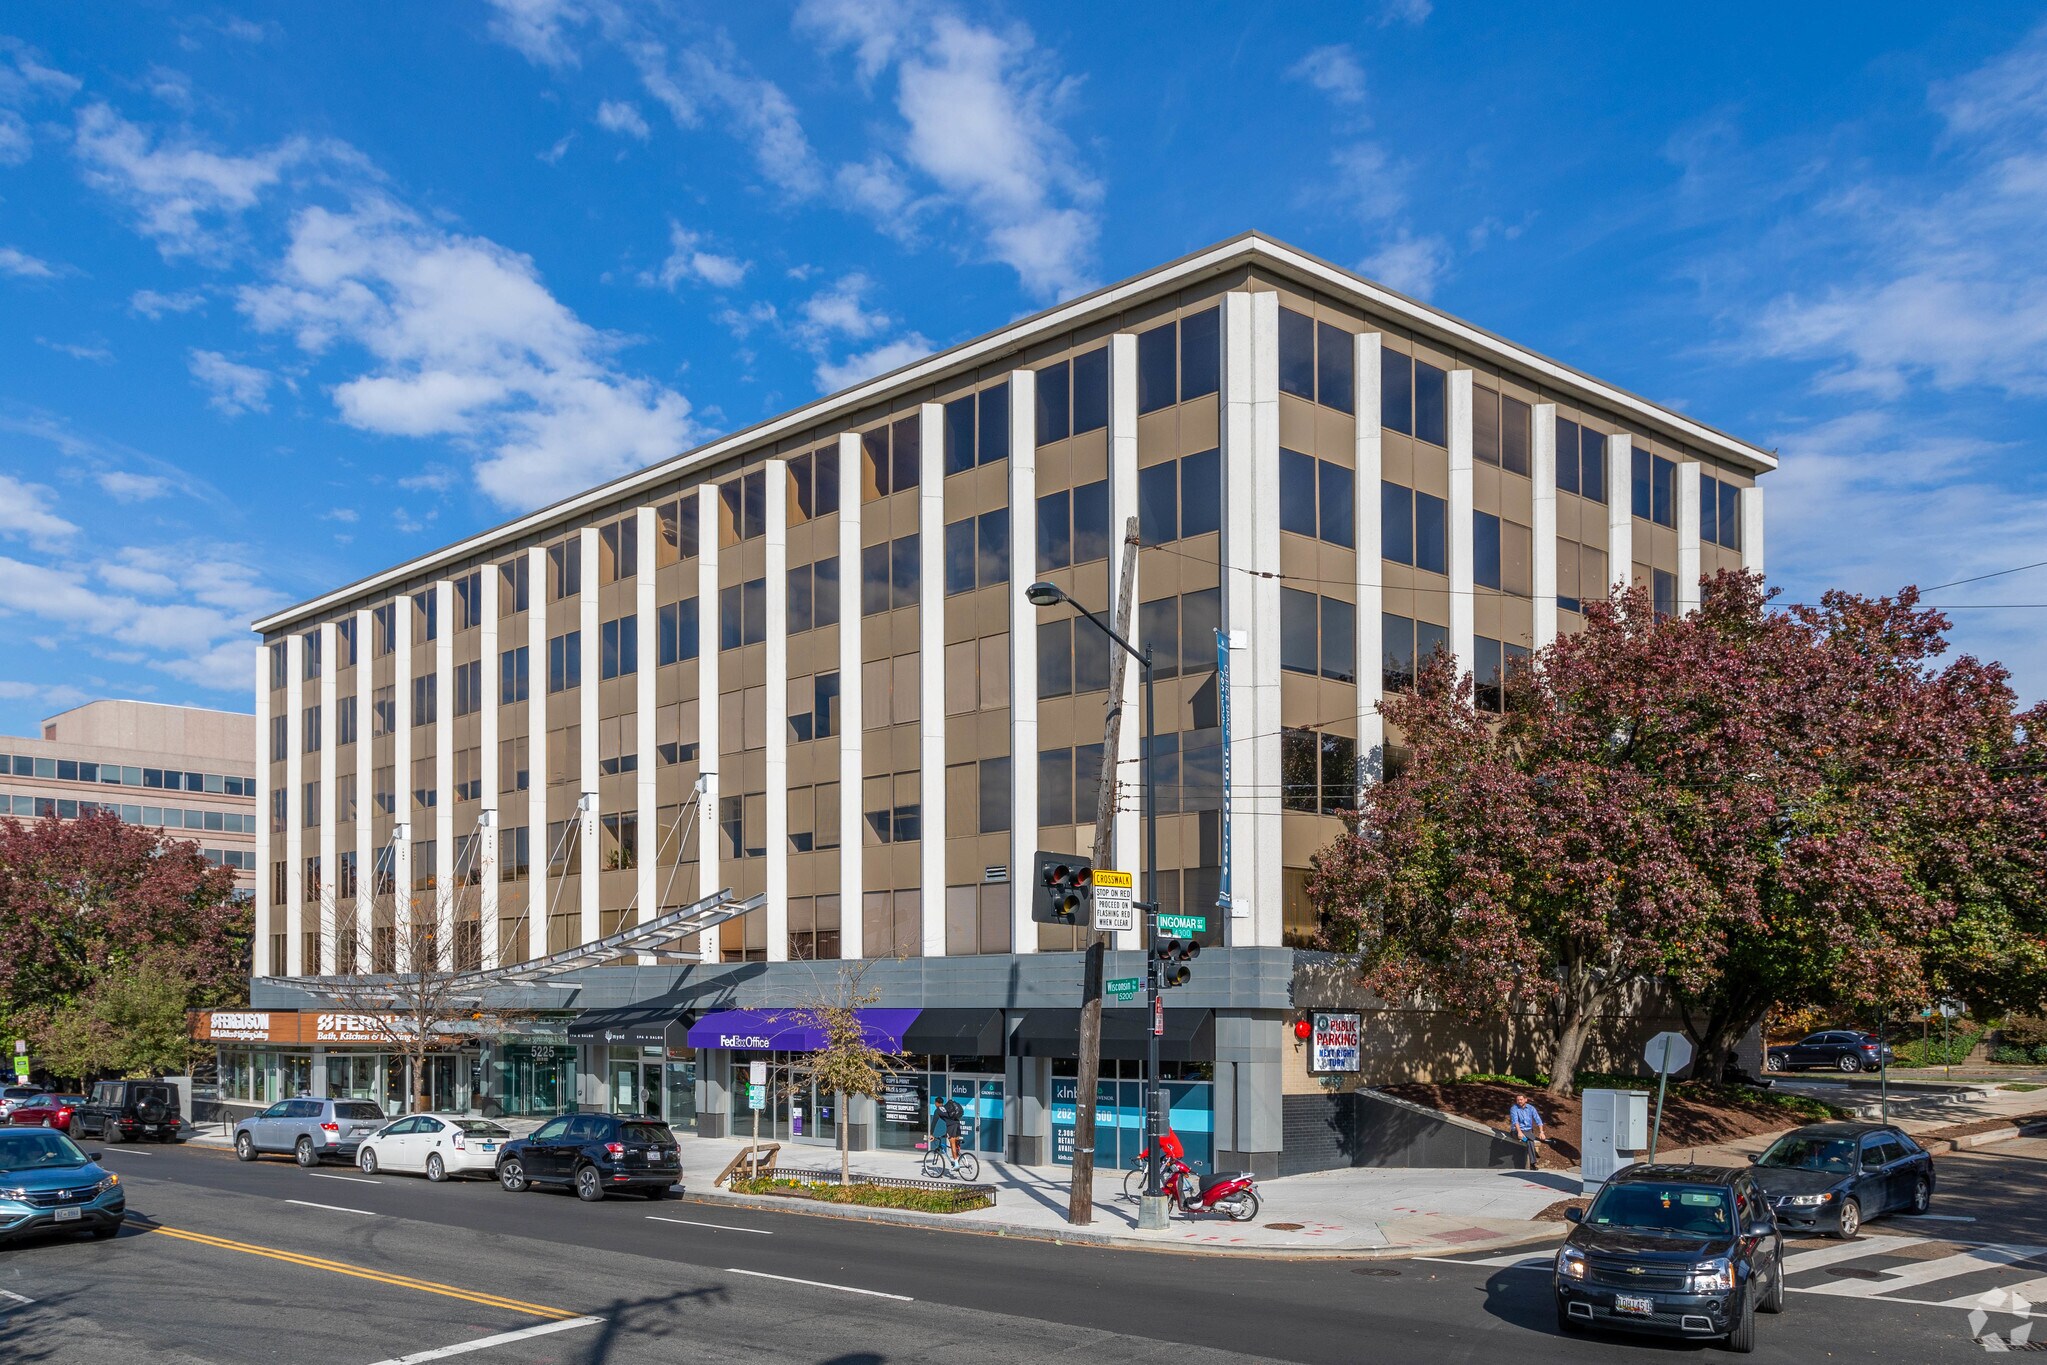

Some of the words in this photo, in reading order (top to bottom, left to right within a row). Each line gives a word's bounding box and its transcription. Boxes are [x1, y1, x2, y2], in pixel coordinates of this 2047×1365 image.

[1096, 874, 1130, 885] CROSSWALK
[1160, 917, 1196, 928] INGOMAR
[1107, 980, 1130, 991] Wisconsin
[220, 1014, 269, 1030] FERGUSON
[1331, 1020, 1357, 1032] PUBLIC
[317, 1032, 338, 1041] Bath,
[340, 1032, 369, 1040] Kitchen
[720, 1035, 746, 1047] FedEx
[746, 1036, 770, 1048] Office
[1317, 1033, 1357, 1046] PARKING
[531, 1046, 554, 1057] 5225
[1319, 1049, 1335, 1057] NEXT
[1337, 1049, 1355, 1058] RIGHT
[1329, 1058, 1345, 1067] TURN
[953, 1085, 967, 1094] klnb
